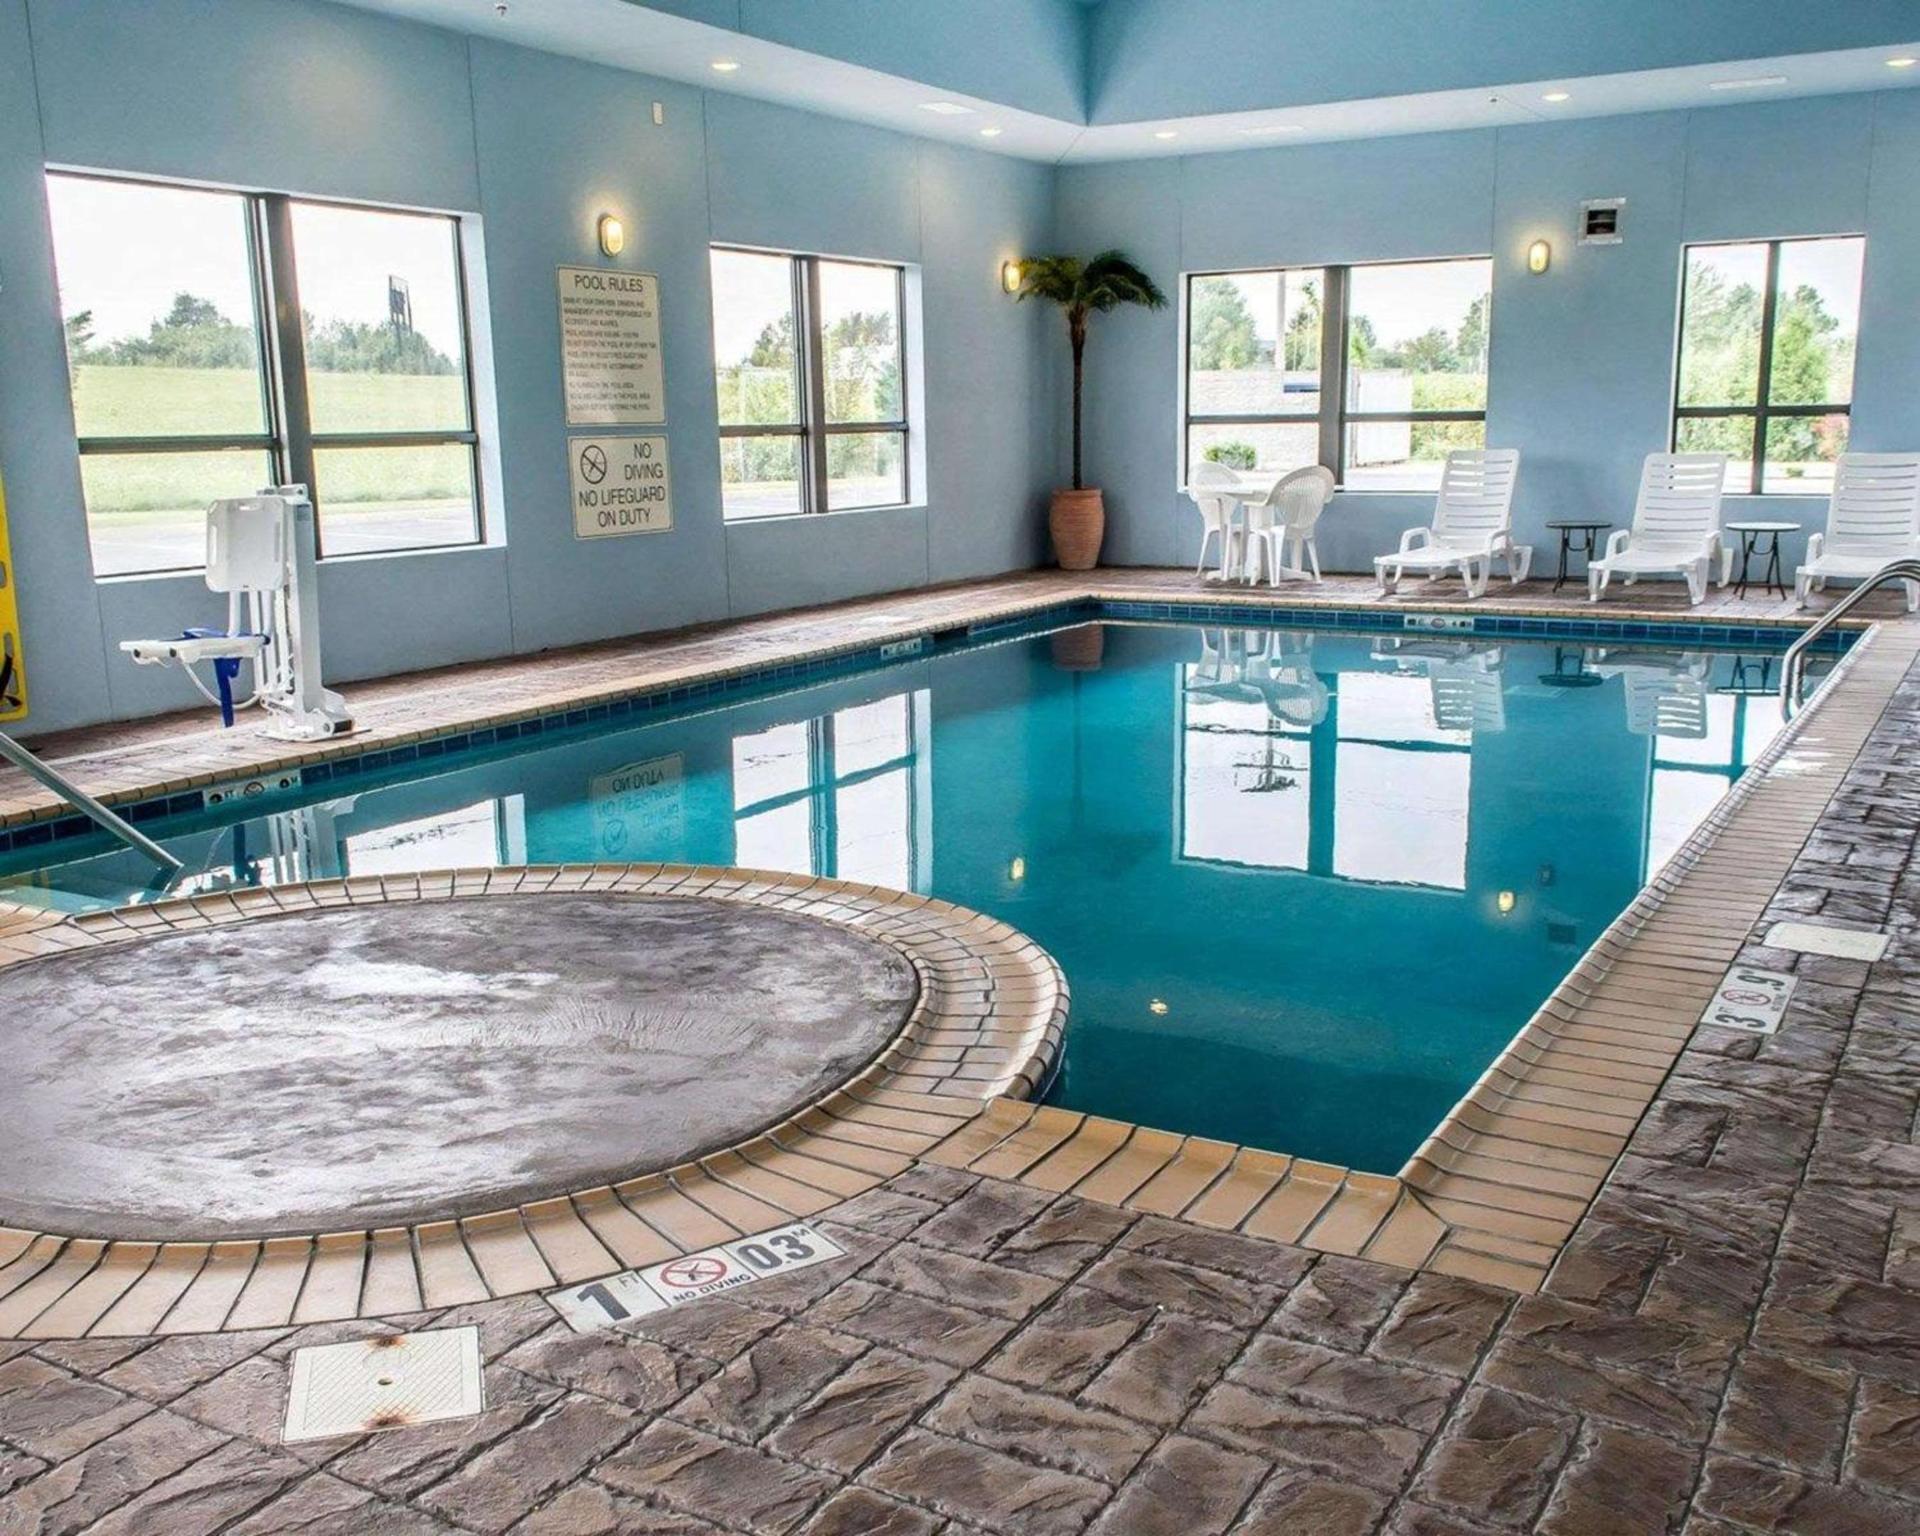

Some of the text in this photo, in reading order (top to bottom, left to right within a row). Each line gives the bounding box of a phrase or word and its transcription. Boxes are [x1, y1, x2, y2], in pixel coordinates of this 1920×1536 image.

[574, 275, 643, 292] POOL RULES
[634, 443, 651, 459] NO
[624, 463, 663, 480] DIVING
[579, 486, 666, 507] NO LIFEGUARD
[598, 508, 650, 527] ON DUTY
[1715, 1014, 1766, 1028] 3
[577, 1273, 639, 1321] 1 FT
[673, 1273, 751, 1303] NO DIVING
